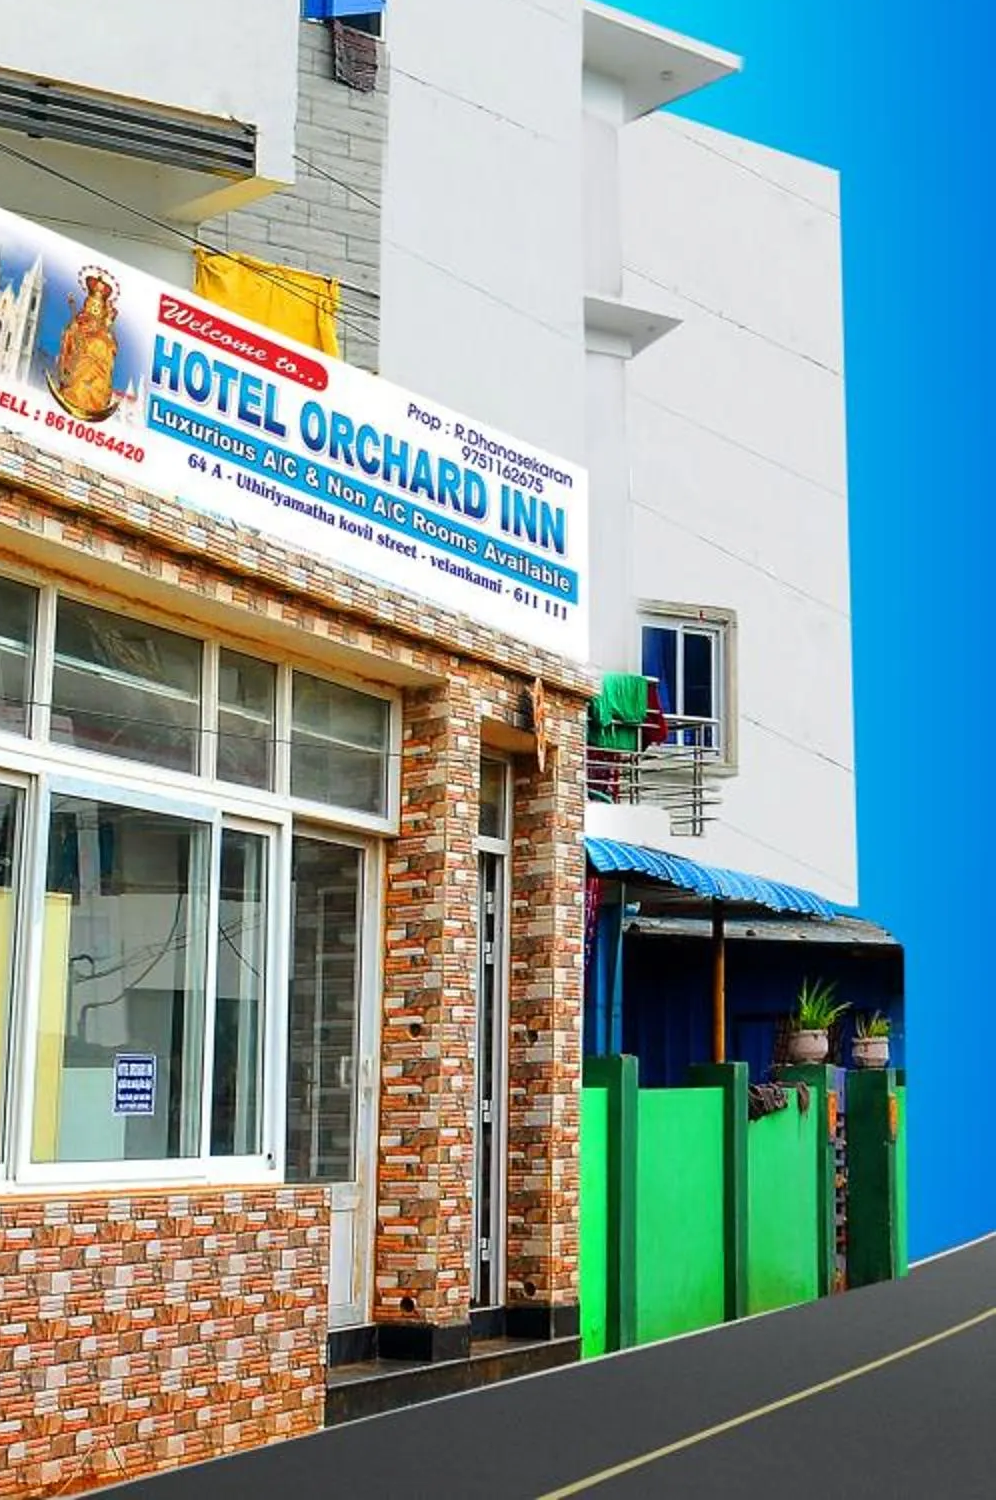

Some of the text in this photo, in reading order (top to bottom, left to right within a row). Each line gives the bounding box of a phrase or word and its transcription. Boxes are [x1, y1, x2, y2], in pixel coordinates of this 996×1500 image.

[161, 299, 268, 361] Welcome
[45, 411, 145, 463] 8610054420
[152, 334, 565, 554] HOTEL ORCHARD INN
[407, 402, 442, 432] Prop
[152, 401, 257, 462] Luxurious
[305, 466, 320, 489] &
[327, 475, 366, 508] Non
[412, 510, 478, 554] Rooms
[484, 541, 572, 592] Available
[461, 445, 544, 494] 9751162675
[188, 453, 207, 473] 64
[211, 463, 223, 480] A
[236, 471, 336, 527] Uthiriyamatha
[338, 514, 374, 541] kovil
[377, 532, 417, 560] street
[430, 555, 502, 594] velankanni
[513, 587, 538, 609] 611
[545, 598, 567, 621] 111
